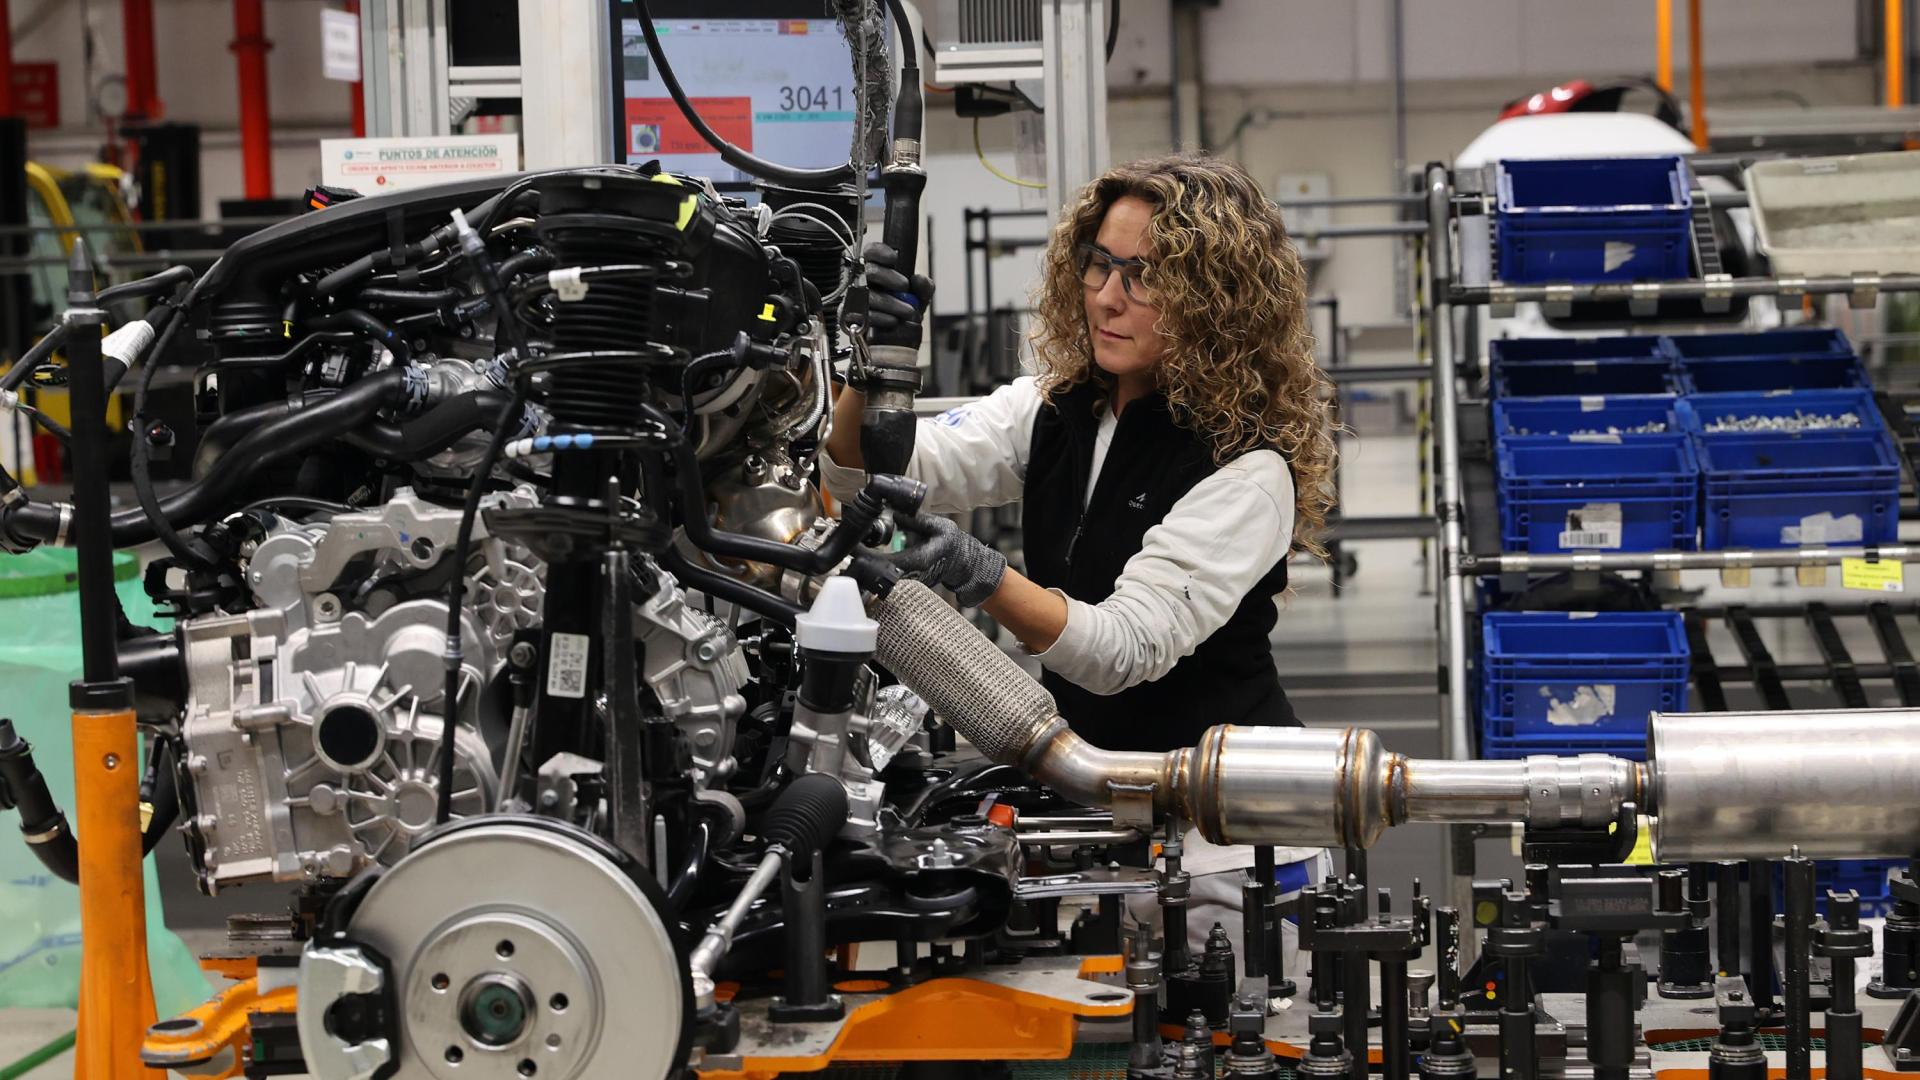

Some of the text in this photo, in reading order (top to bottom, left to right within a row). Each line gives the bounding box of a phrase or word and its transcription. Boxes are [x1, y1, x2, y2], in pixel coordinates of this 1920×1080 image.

[780, 86, 842, 111] 3041
[379, 149, 422, 161] PUNTOS
[426, 148, 439, 159] DE
[443, 145, 497, 159] ATENCIÓN
